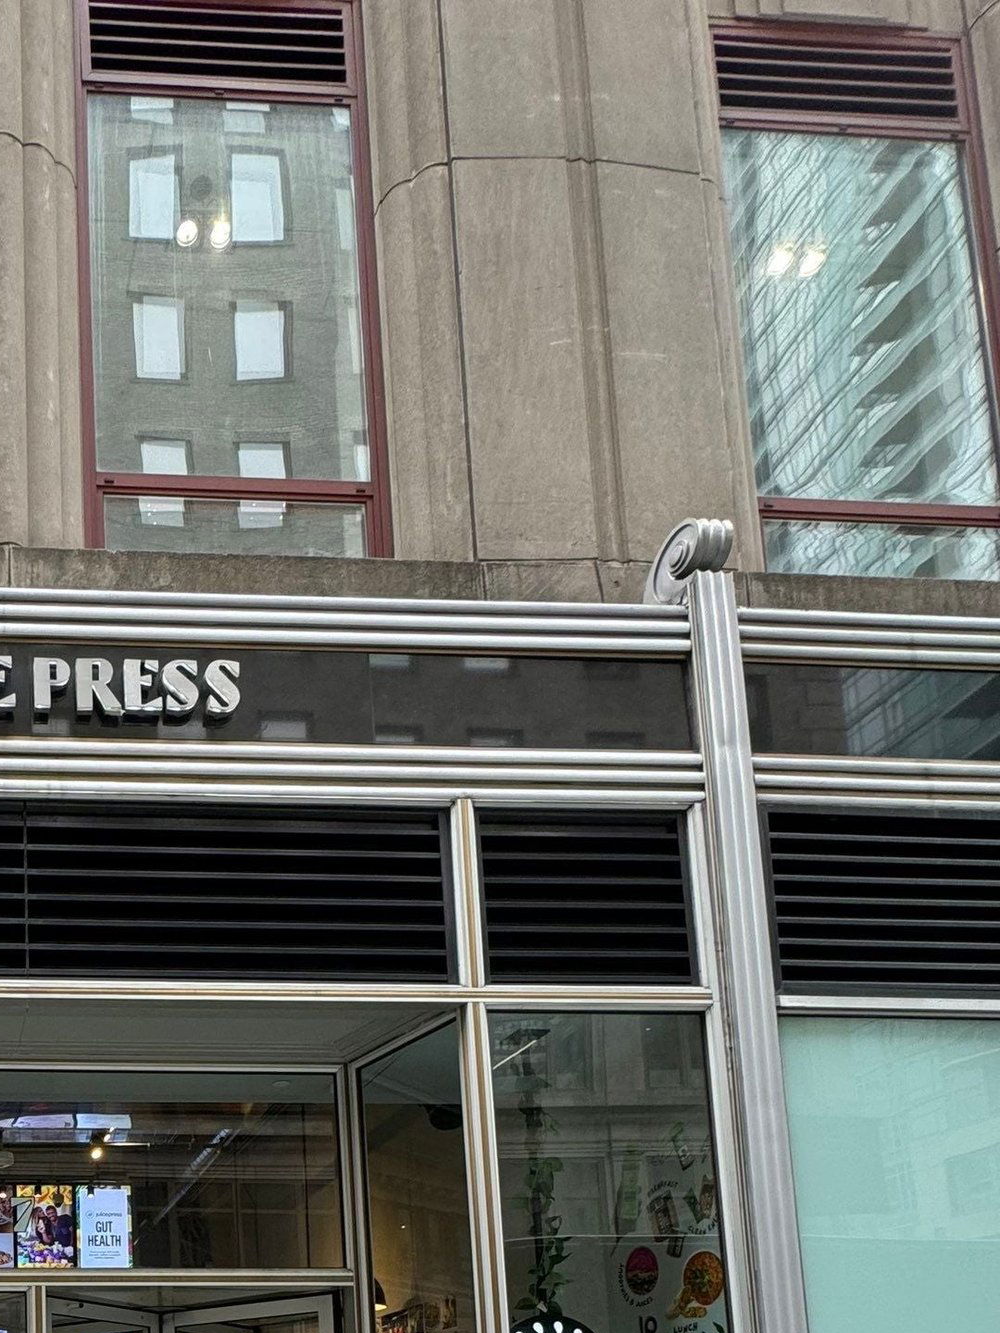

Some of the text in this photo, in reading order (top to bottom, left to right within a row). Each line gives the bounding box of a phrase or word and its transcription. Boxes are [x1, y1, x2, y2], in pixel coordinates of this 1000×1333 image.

[33, 656, 241, 717] PRESS
[95, 1221, 113, 1233] GUT
[88, 1235, 121, 1247] HEALTH
